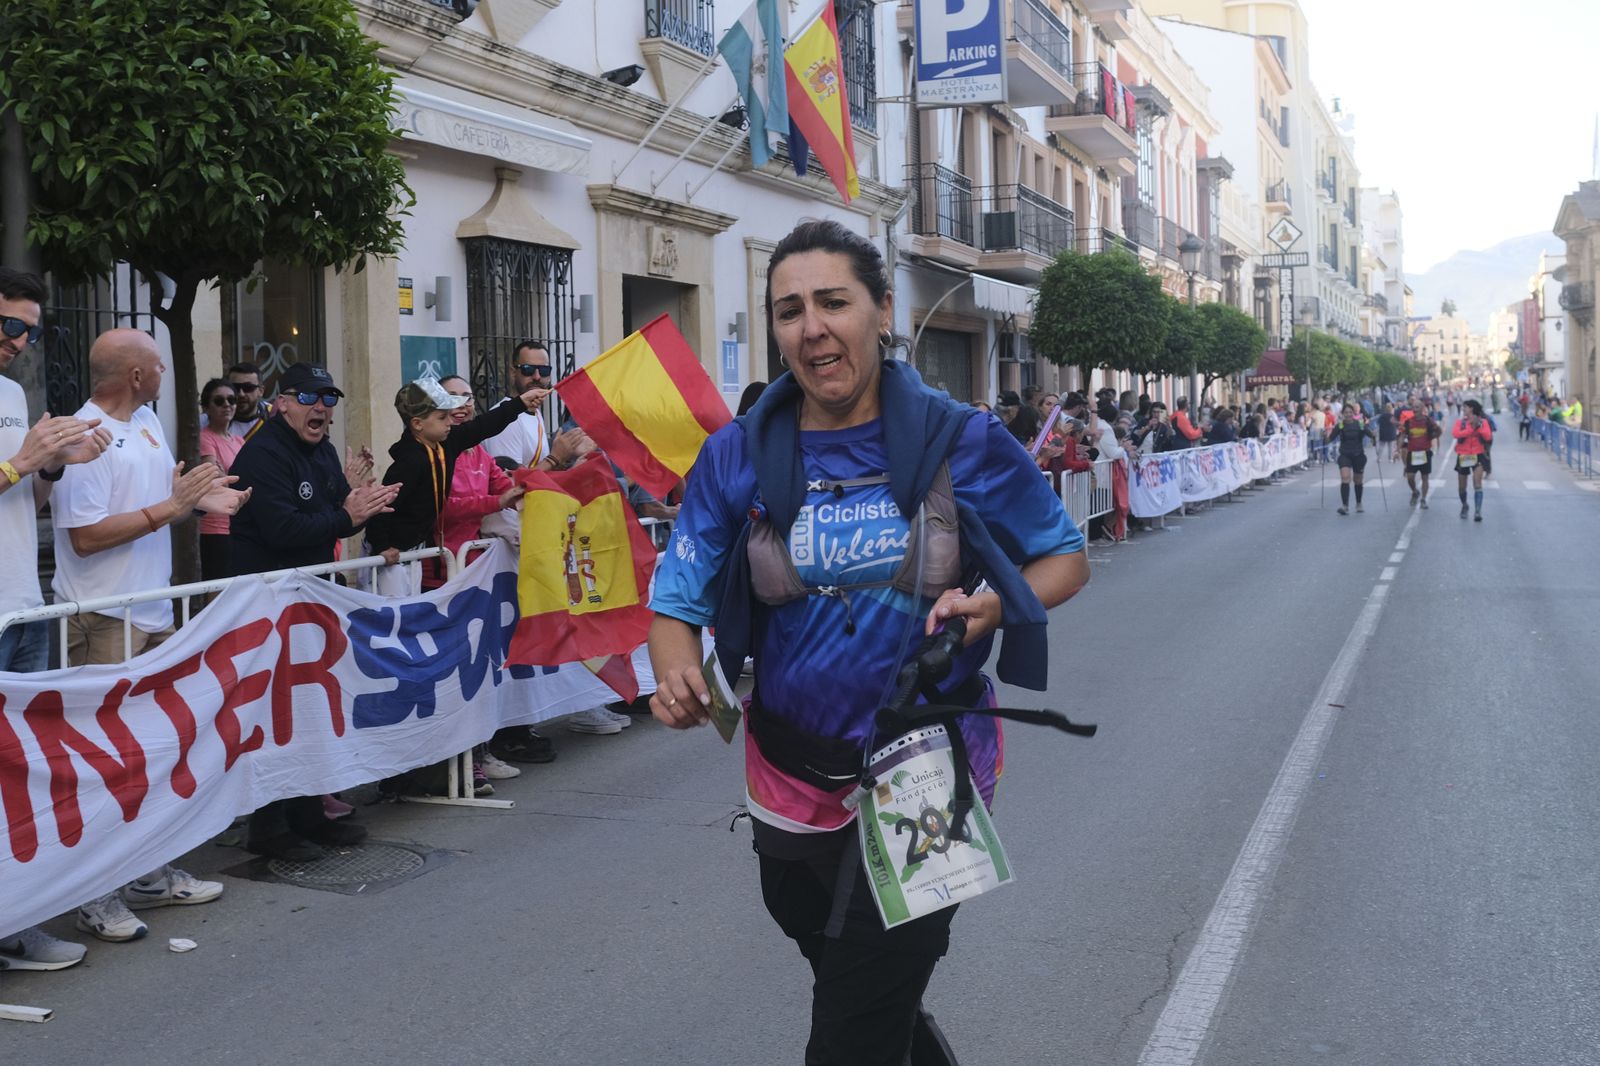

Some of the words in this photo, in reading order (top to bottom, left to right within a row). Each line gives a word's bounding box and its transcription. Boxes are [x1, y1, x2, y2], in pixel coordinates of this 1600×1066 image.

[920, 83, 999, 97] MAESTRANZA
[940, 77, 978, 87] HOTEL
[726, 344, 736, 369] H
[0, 571, 560, 864] INTERSPOR
